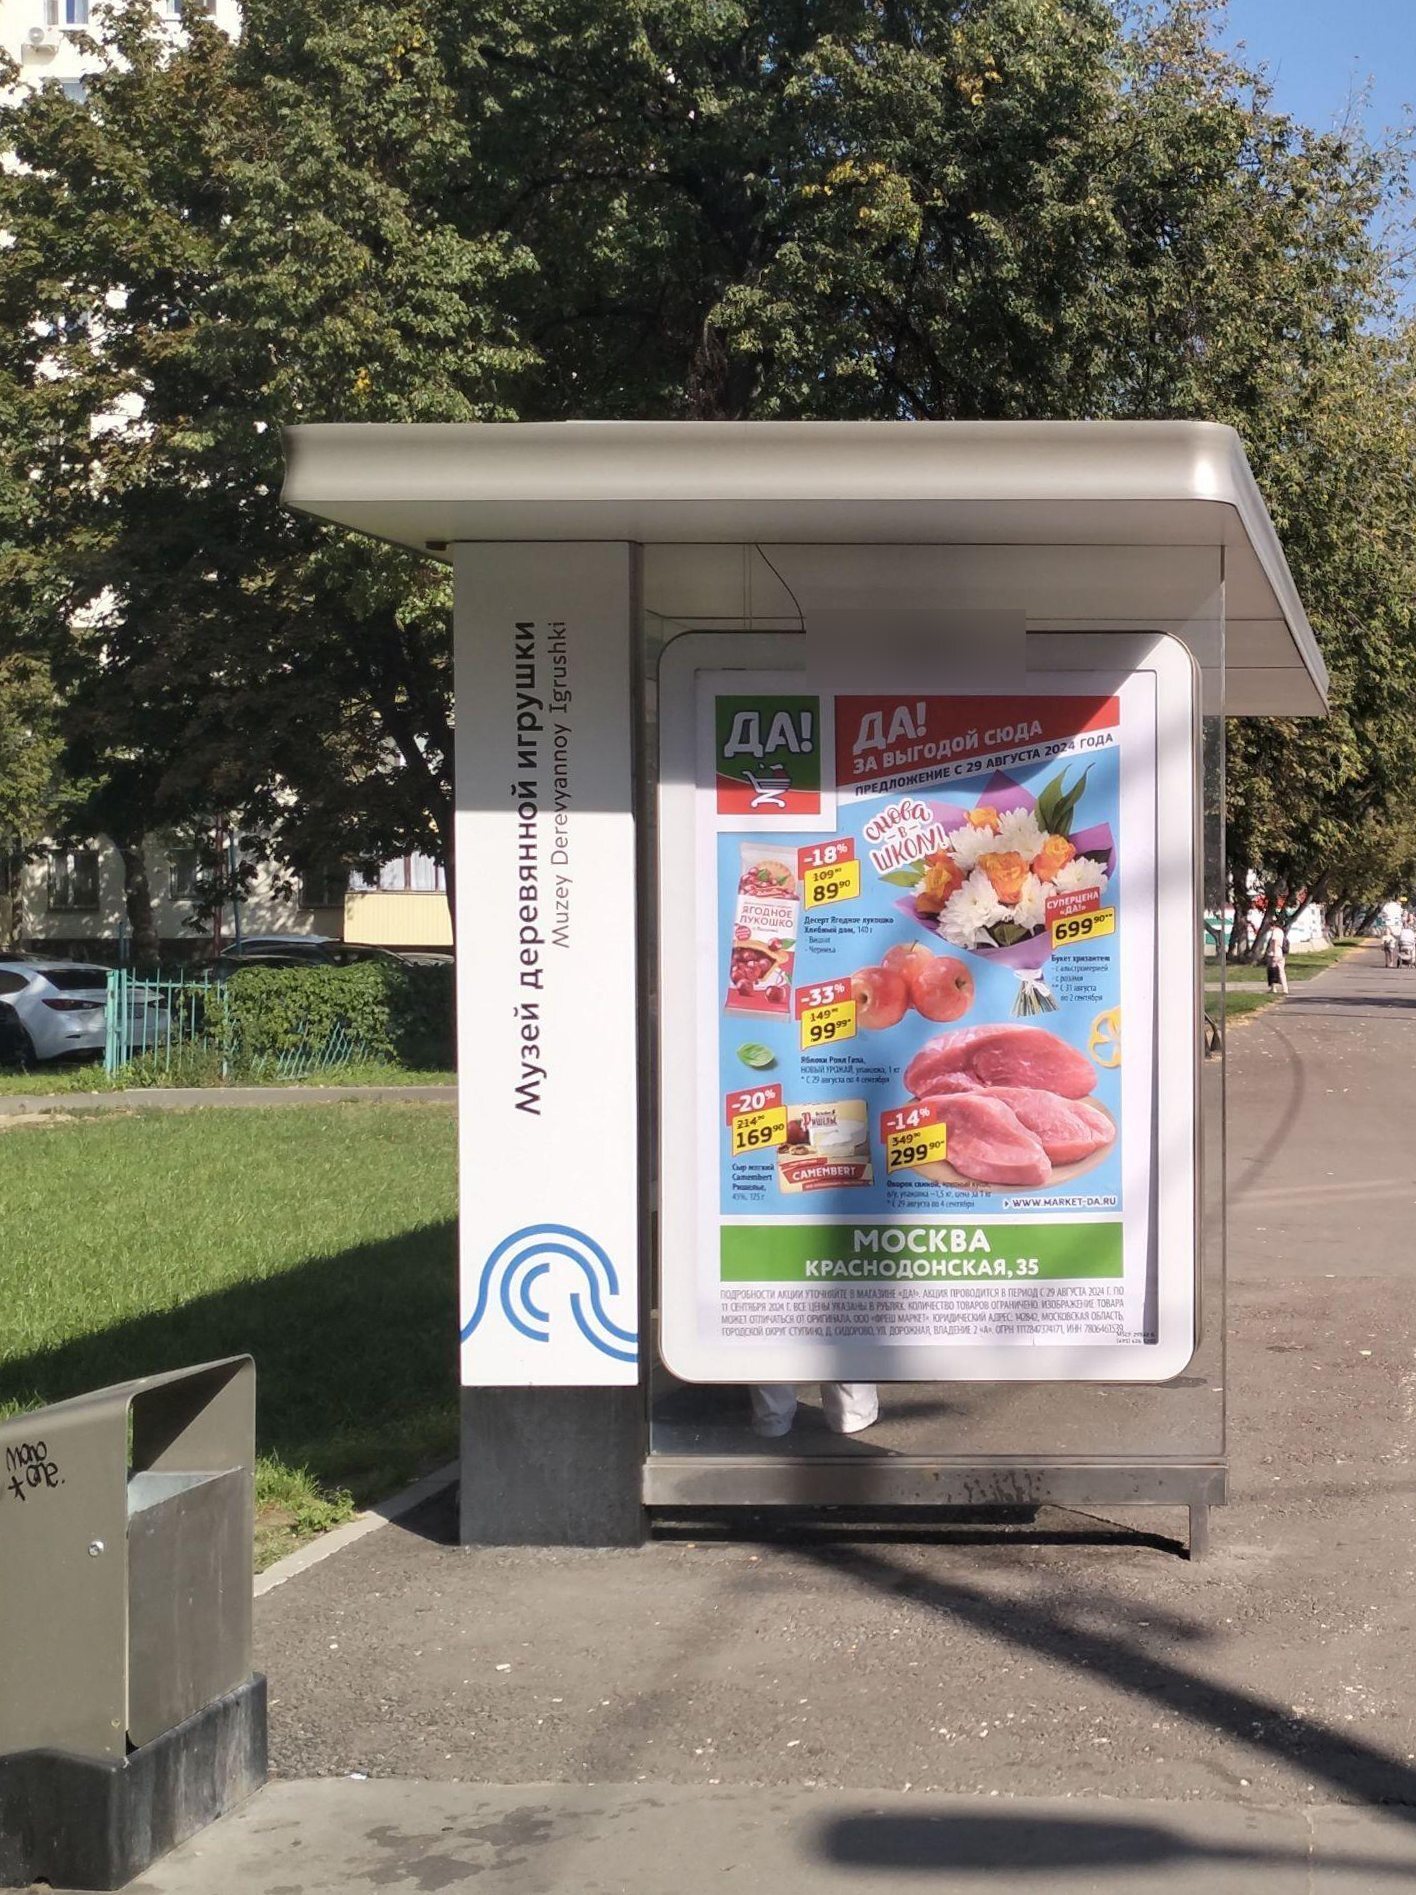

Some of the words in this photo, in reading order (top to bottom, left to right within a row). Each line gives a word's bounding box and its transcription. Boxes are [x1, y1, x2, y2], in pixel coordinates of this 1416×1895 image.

[547, 621, 572, 713] Igrushki
[515, 621, 544, 768] игрушки
[724, 710, 814, 758] ДА!
[853, 701, 927, 756] ДА!
[853, 757, 878, 775] ЗА
[882, 729, 978, 768] ВЫГОДОЙ
[984, 719, 1043, 746] СЮДА
[855, 767, 951, 797] ПРЕДЛОЖЕНИЕ
[954, 763, 963, 776] С
[966, 759, 982, 774] 29
[986, 747, 1041, 770] АВГУСТА
[1045, 740, 1075, 757] 2024
[1080, 733, 1114, 750] ГОДА
[550, 723, 573, 865] Derevyannoy
[872, 825, 946, 871] ШКОЛУ!
[511, 781, 545, 990] деревянной
[1046, 891, 1099, 909] СУПЕРЦЕНА
[551, 874, 573, 949] Muzey
[740, 914, 794, 928] ЛУКОШКО
[741, 905, 793, 919] ЯГОДНОЕ
[513, 1003, 547, 1116] Музей
[792, 1165, 856, 1181] CAMEMBERT
[1012, 1197, 1116, 1207] WWW.MARKET-DA.RU
[853, 1229, 991, 1254] МОСКВА
[805, 1259, 1014, 1279] КРАСНОДОНСКАЯ,
[1016, 1258, 1039, 1276] 35
[720, 1289, 775, 1300] ПОДРОБНОСТИ
[950, 1288, 999, 1299] ПРОВОДИТСЯ
[1008, 1287, 1038, 1298] ПЕРИОД
[1056, 1287, 1086, 1297] АВГУСТА
